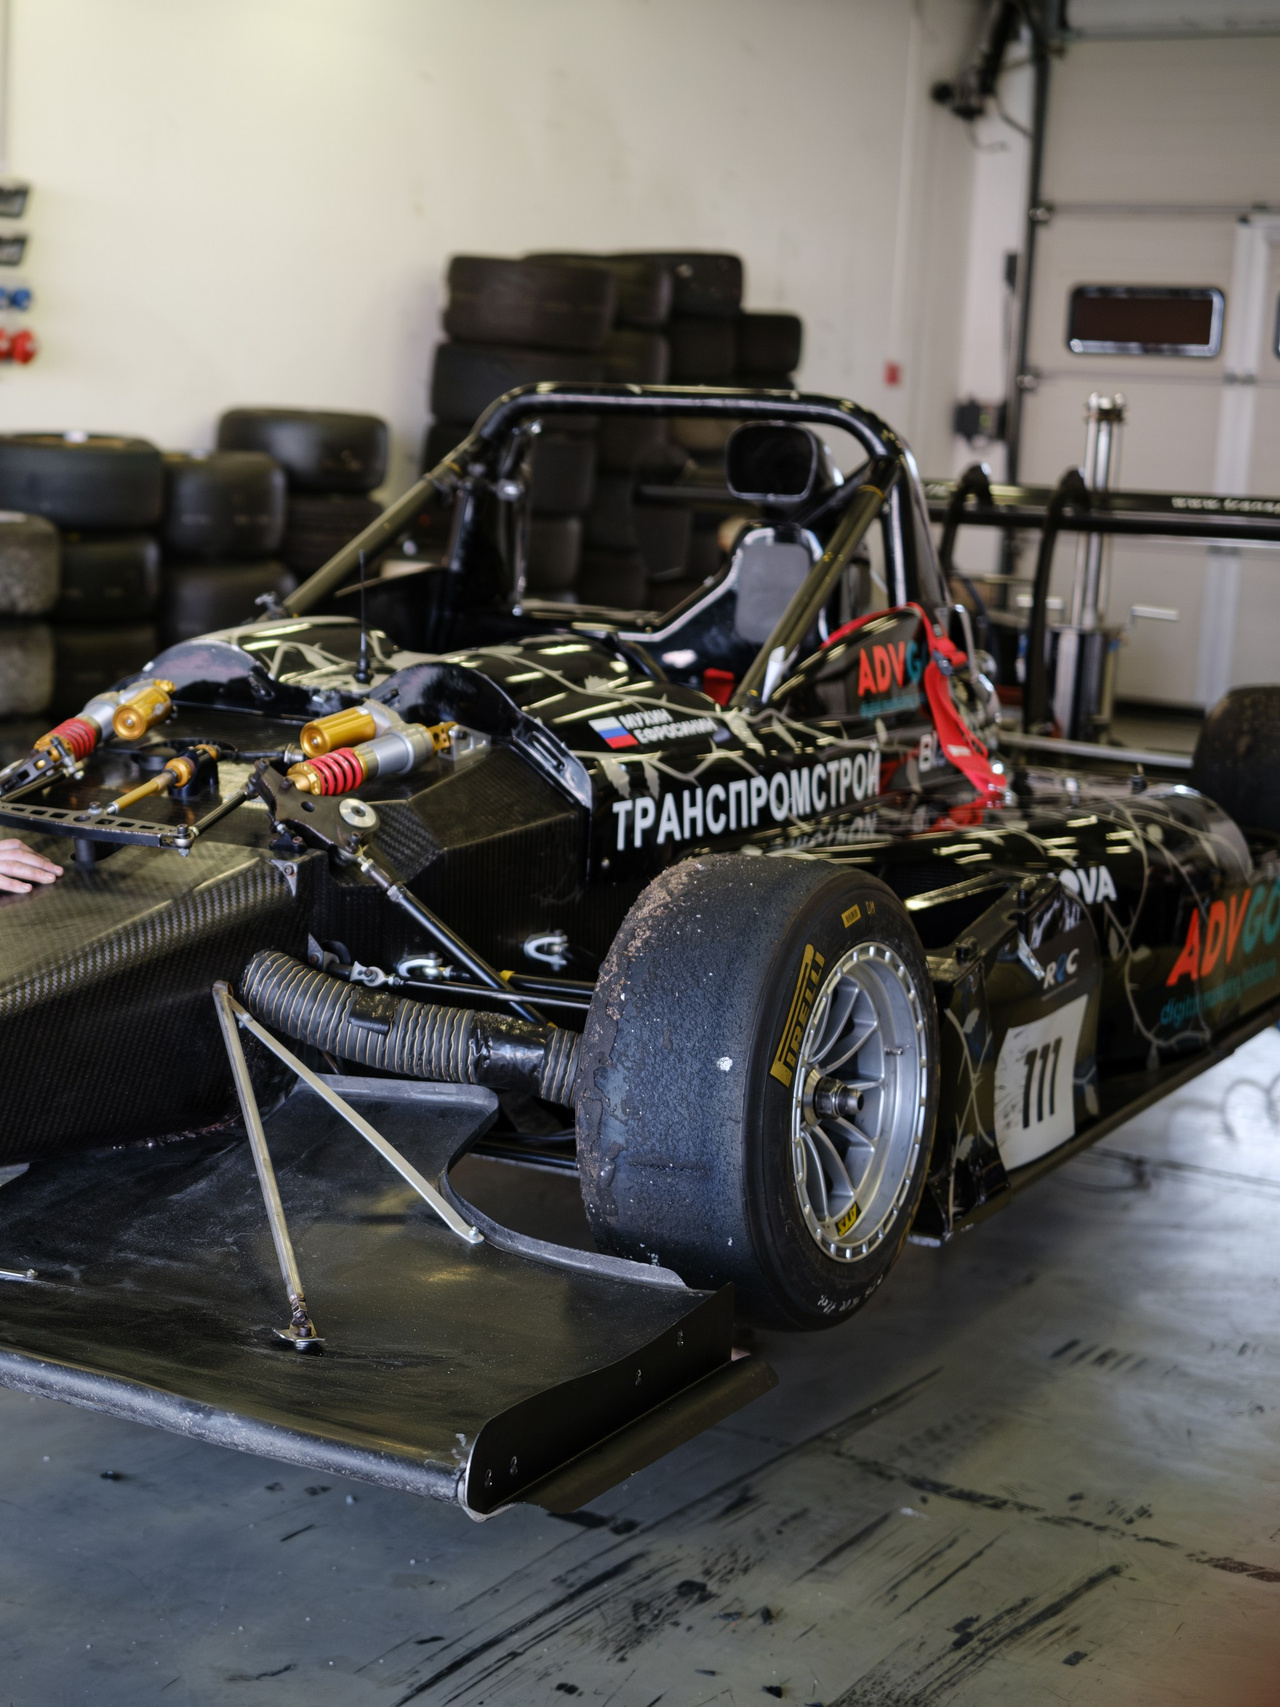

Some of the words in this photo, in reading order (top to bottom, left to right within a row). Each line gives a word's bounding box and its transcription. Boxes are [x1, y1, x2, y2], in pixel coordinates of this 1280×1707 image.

[618, 708, 673, 730] МУХИН
[770, 944, 826, 1088] PIRELLI
[1023, 1035, 1062, 1129] 111
